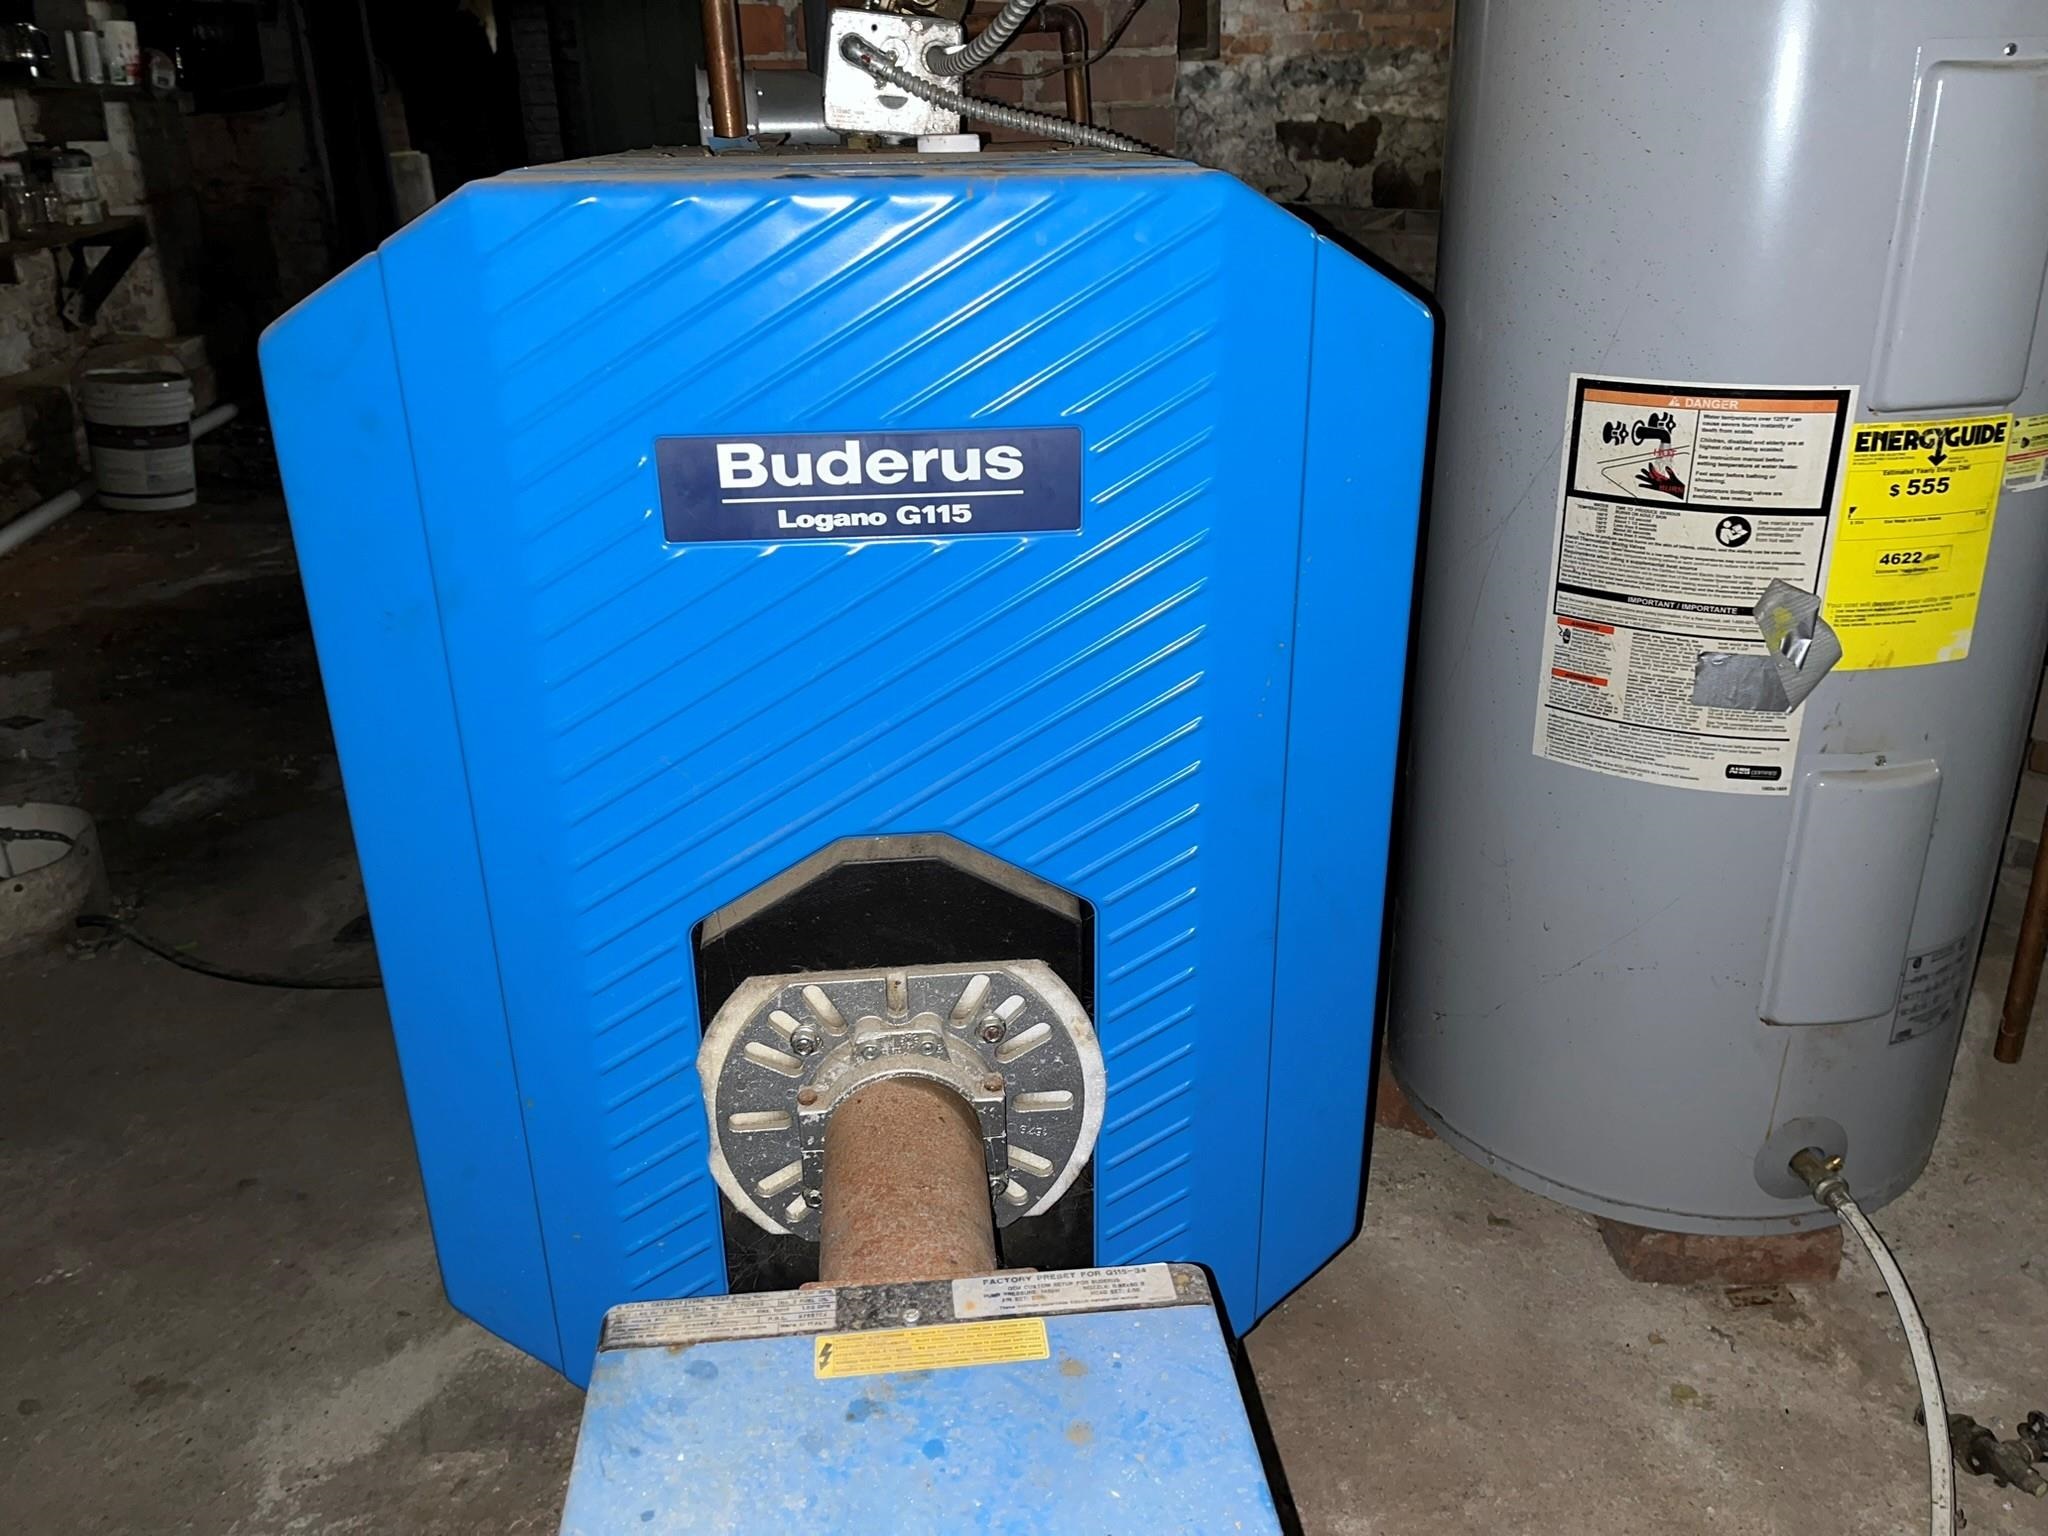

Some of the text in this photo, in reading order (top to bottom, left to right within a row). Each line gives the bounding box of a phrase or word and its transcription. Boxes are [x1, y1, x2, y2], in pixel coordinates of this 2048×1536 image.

[1685, 397, 1739, 410] DANGER
[1855, 422, 2008, 452] ENERGYGUIDE
[716, 440, 1024, 489] Buderus
[1890, 477, 1950, 497] $ 555
[778, 504, 972, 532] Logano G115
[1880, 552, 1922, 564] 4622
[1628, 596, 1675, 609] IMPORTANT
[1681, 601, 1738, 614] IMPORTANTE
[983, 1276, 1032, 1285] FACTORY
